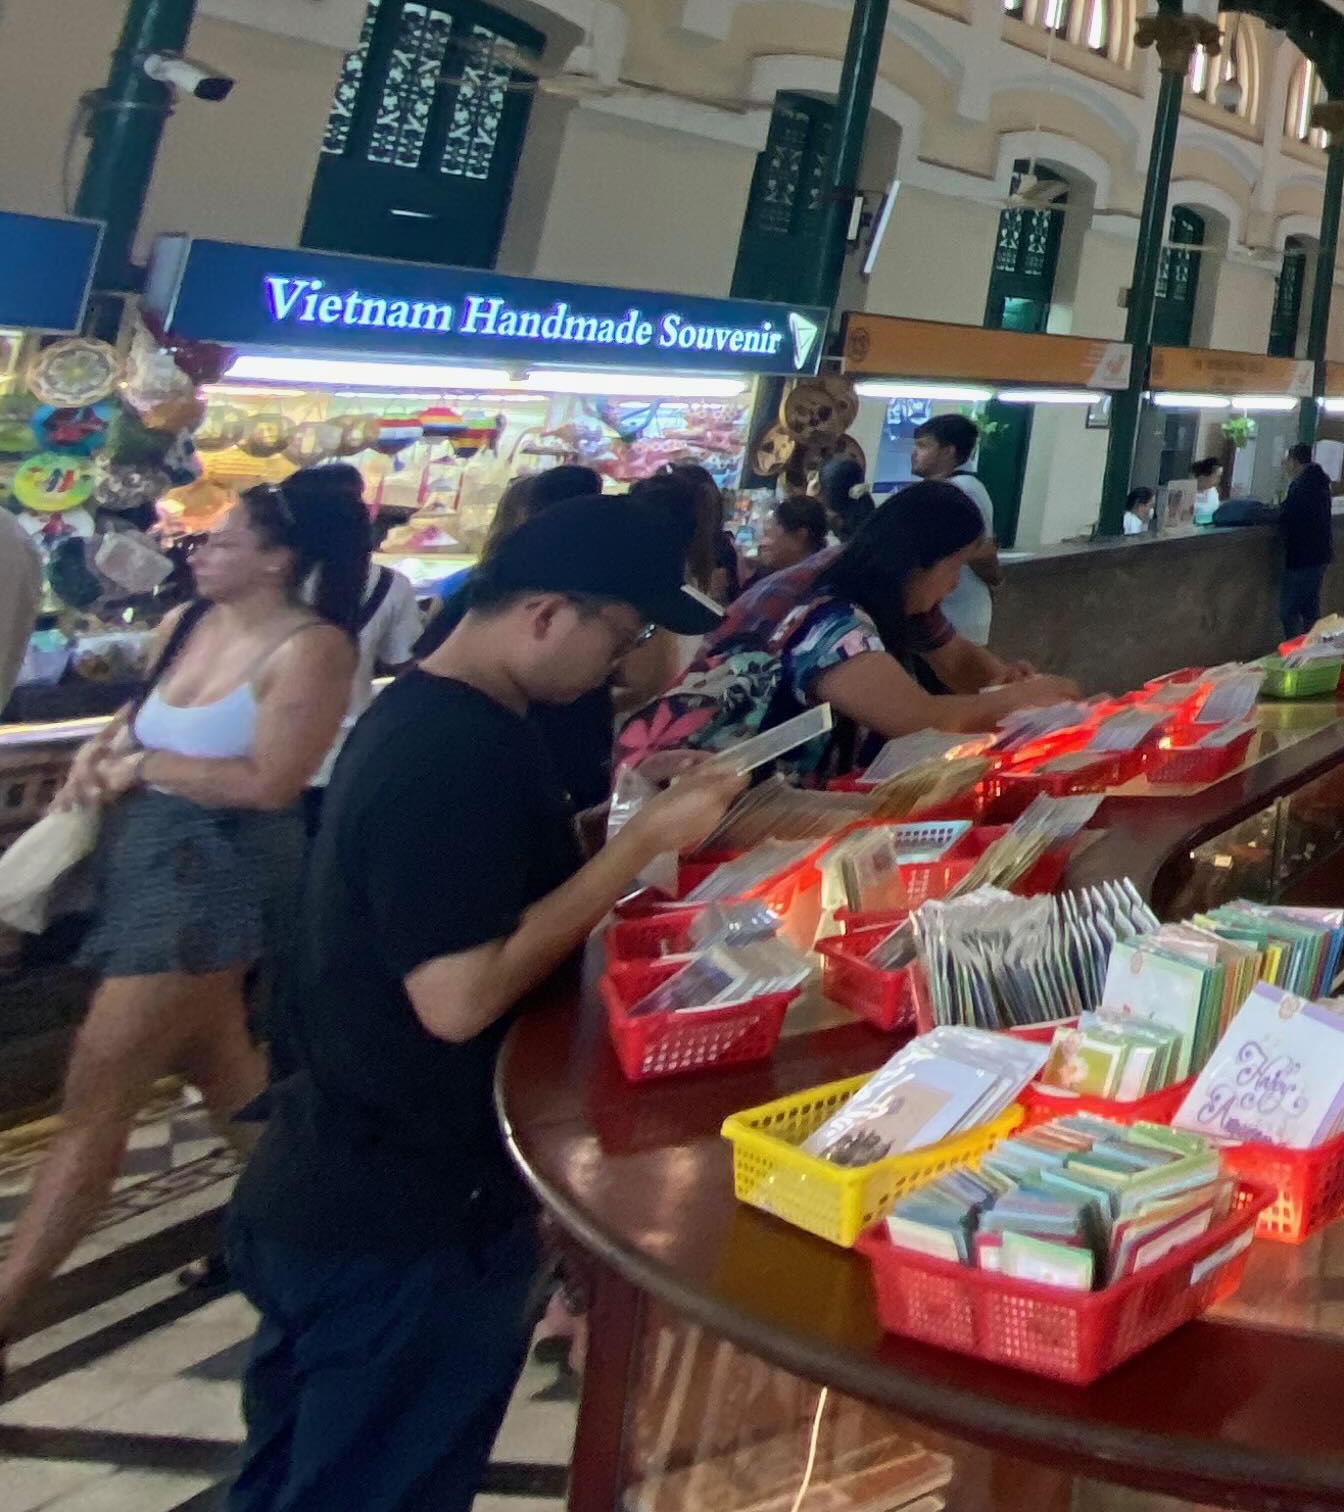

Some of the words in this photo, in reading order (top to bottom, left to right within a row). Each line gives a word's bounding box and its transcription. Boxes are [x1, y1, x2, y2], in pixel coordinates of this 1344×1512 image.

[266, 276, 452, 332] Vietnam
[460, 295, 652, 346] Handmade
[659, 313, 783, 355] Souvenir
